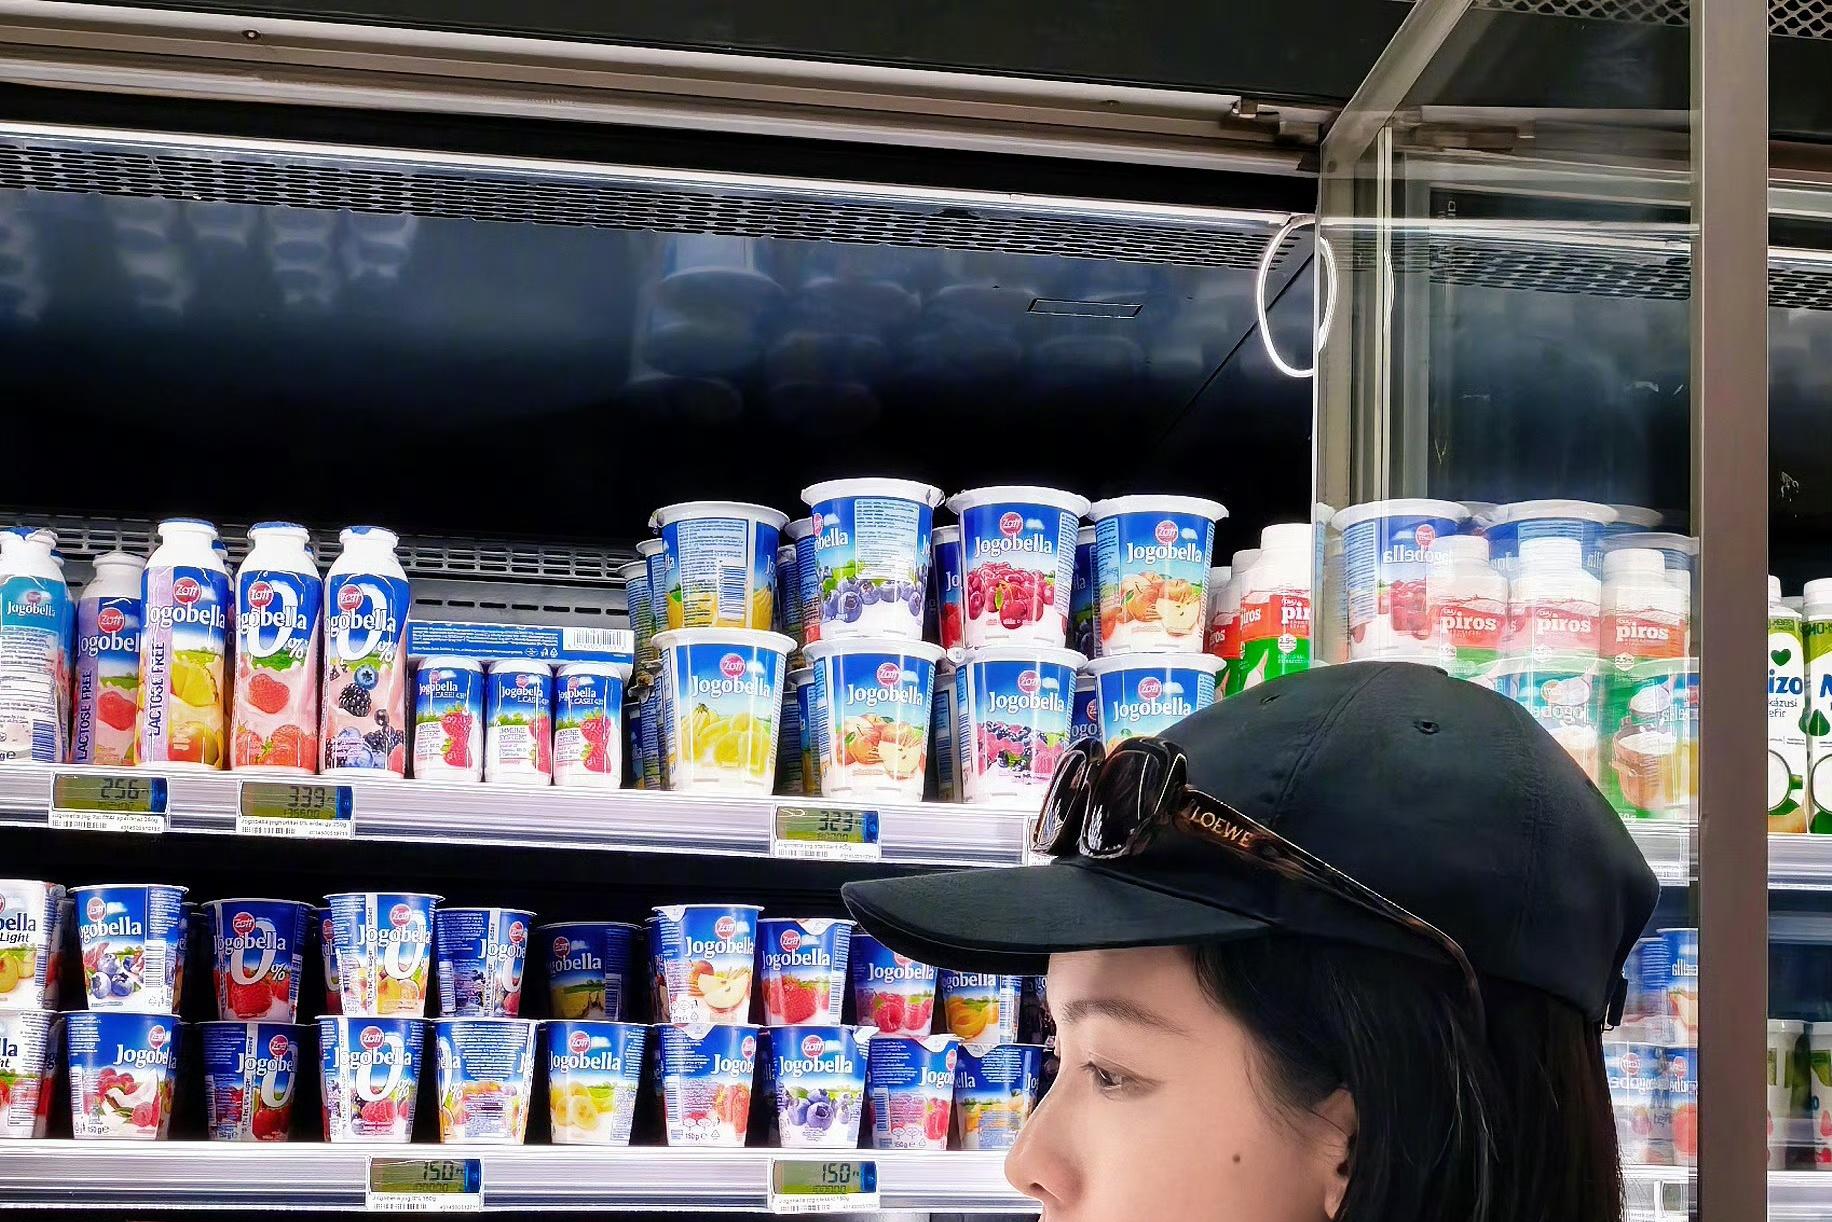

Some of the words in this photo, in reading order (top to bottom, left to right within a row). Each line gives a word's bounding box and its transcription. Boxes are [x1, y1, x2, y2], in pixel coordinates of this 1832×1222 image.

[815, 527, 848, 552] bella
[974, 530, 1052, 557] Jogobella
[1126, 540, 1202, 564] Jogobella
[7, 601, 56, 617] Jogobella
[145, 601, 225, 627] Jogobella
[236, 604, 307, 634] ogobella
[1241, 607, 1261, 627] iros
[325, 609, 396, 637] ogobella
[1440, 611, 1497, 635] piros
[1535, 613, 1592, 634] piros
[1616, 622, 1669, 642] piros
[78, 631, 140, 656] Jogobel
[501, 686, 543, 698] Jogobella
[692, 673, 771, 697] Jogobella
[1768, 669, 1803, 695] izo
[848, 682, 923, 706] Jogobella
[989, 691, 1065, 714] Jogobella
[1113, 697, 1192, 722] Jogobella
[77, 705, 91, 762] LACTOSE
[100, 778, 139, 799] 256
[288, 786, 326, 808] 339
[818, 810, 854, 831] 323
[1190, 804, 1254, 848] LOEWE
[80, 915, 142, 943] ogobella
[358, 925, 432, 947] Jogobella
[213, 931, 287, 955] Jogobella
[478, 938, 526, 960] Jogobe
[685, 935, 754, 958] Jogobella
[551, 954, 602, 974] gobella
[762, 948, 831, 969] Jogobella
[867, 963, 934, 983] Jogobella
[941, 973, 997, 992] ogobella
[113, 1043, 170, 1069] Jogobel
[334, 1047, 412, 1068] Jogobella
[551, 1050, 622, 1072] Jogobella
[711, 1053, 754, 1076] Jogob
[780, 1055, 853, 1078] Jogobella
[920, 1066, 955, 1089] Jogob
[822, 1163, 851, 1183] 150
